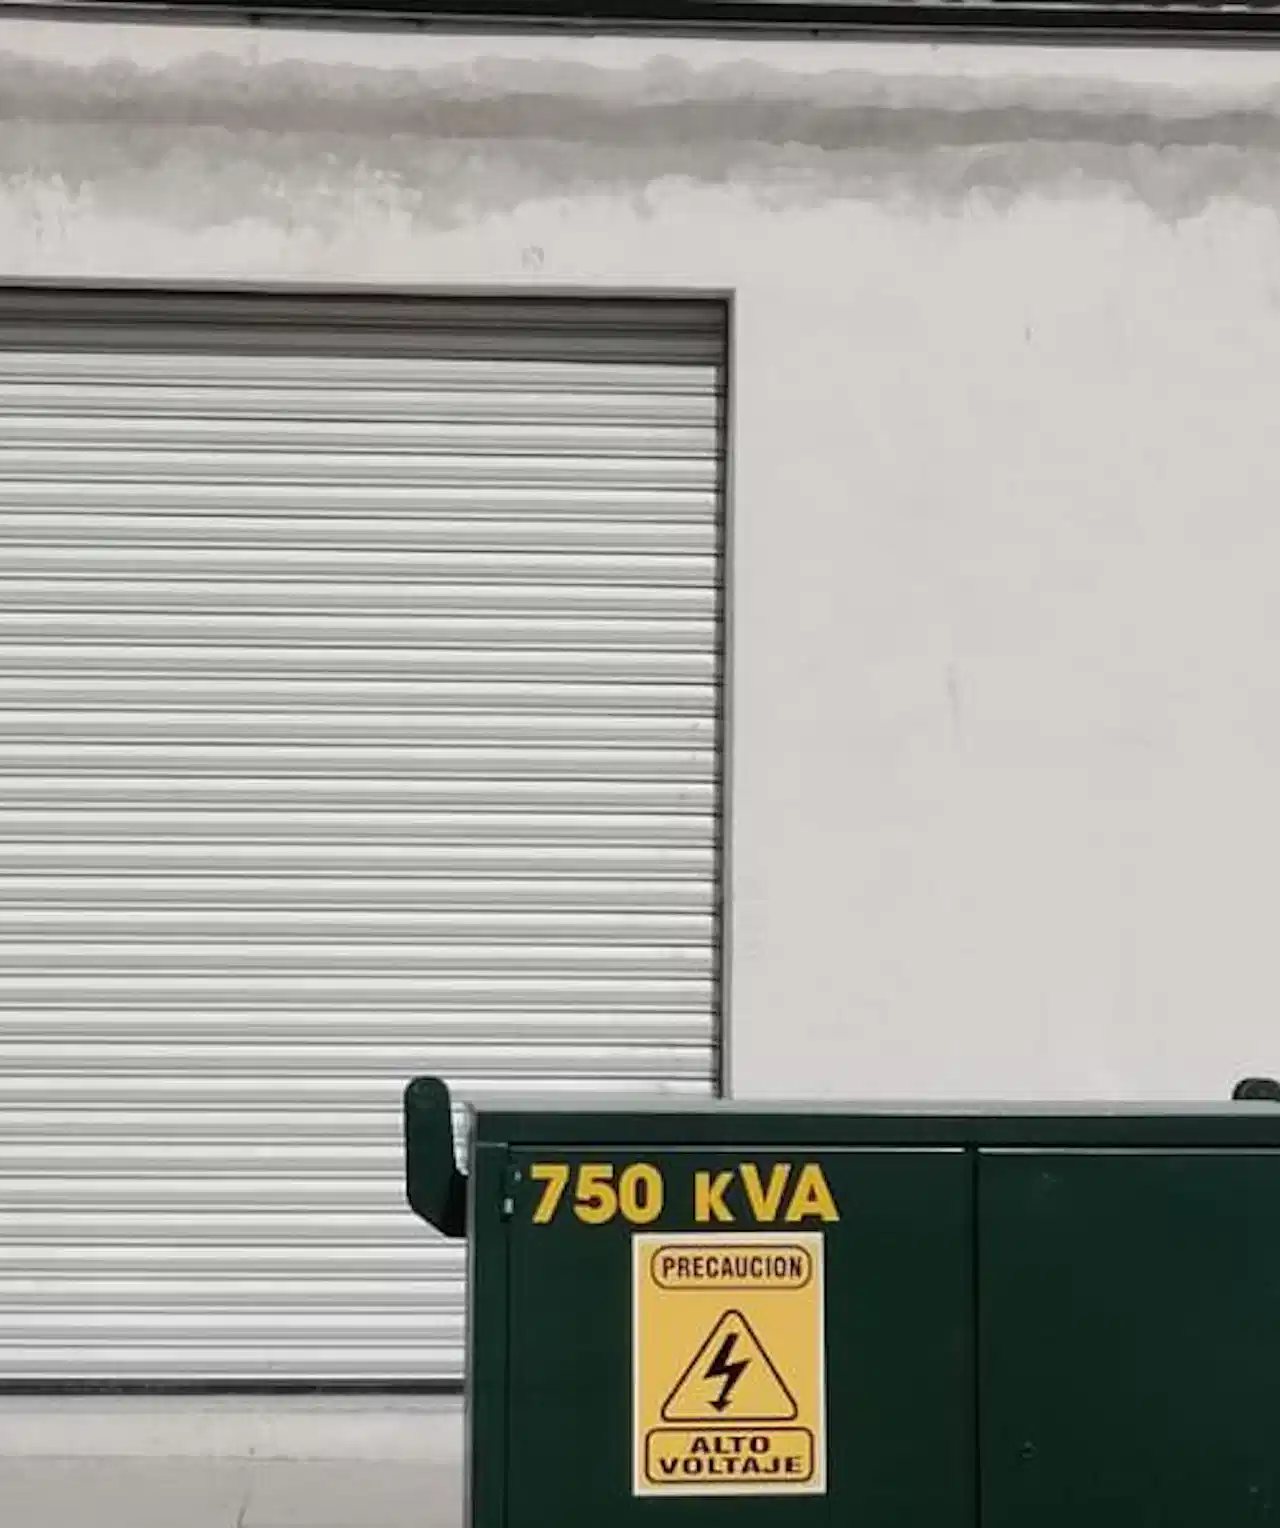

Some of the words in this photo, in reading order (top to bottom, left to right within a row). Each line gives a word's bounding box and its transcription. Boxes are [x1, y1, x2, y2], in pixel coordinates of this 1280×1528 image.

[530, 1163, 663, 1224] 750
[661, 1256, 803, 1279] PRECAUCION
[690, 1436, 770, 1454] ALTO
[659, 1456, 803, 1474] VOLTAJE
